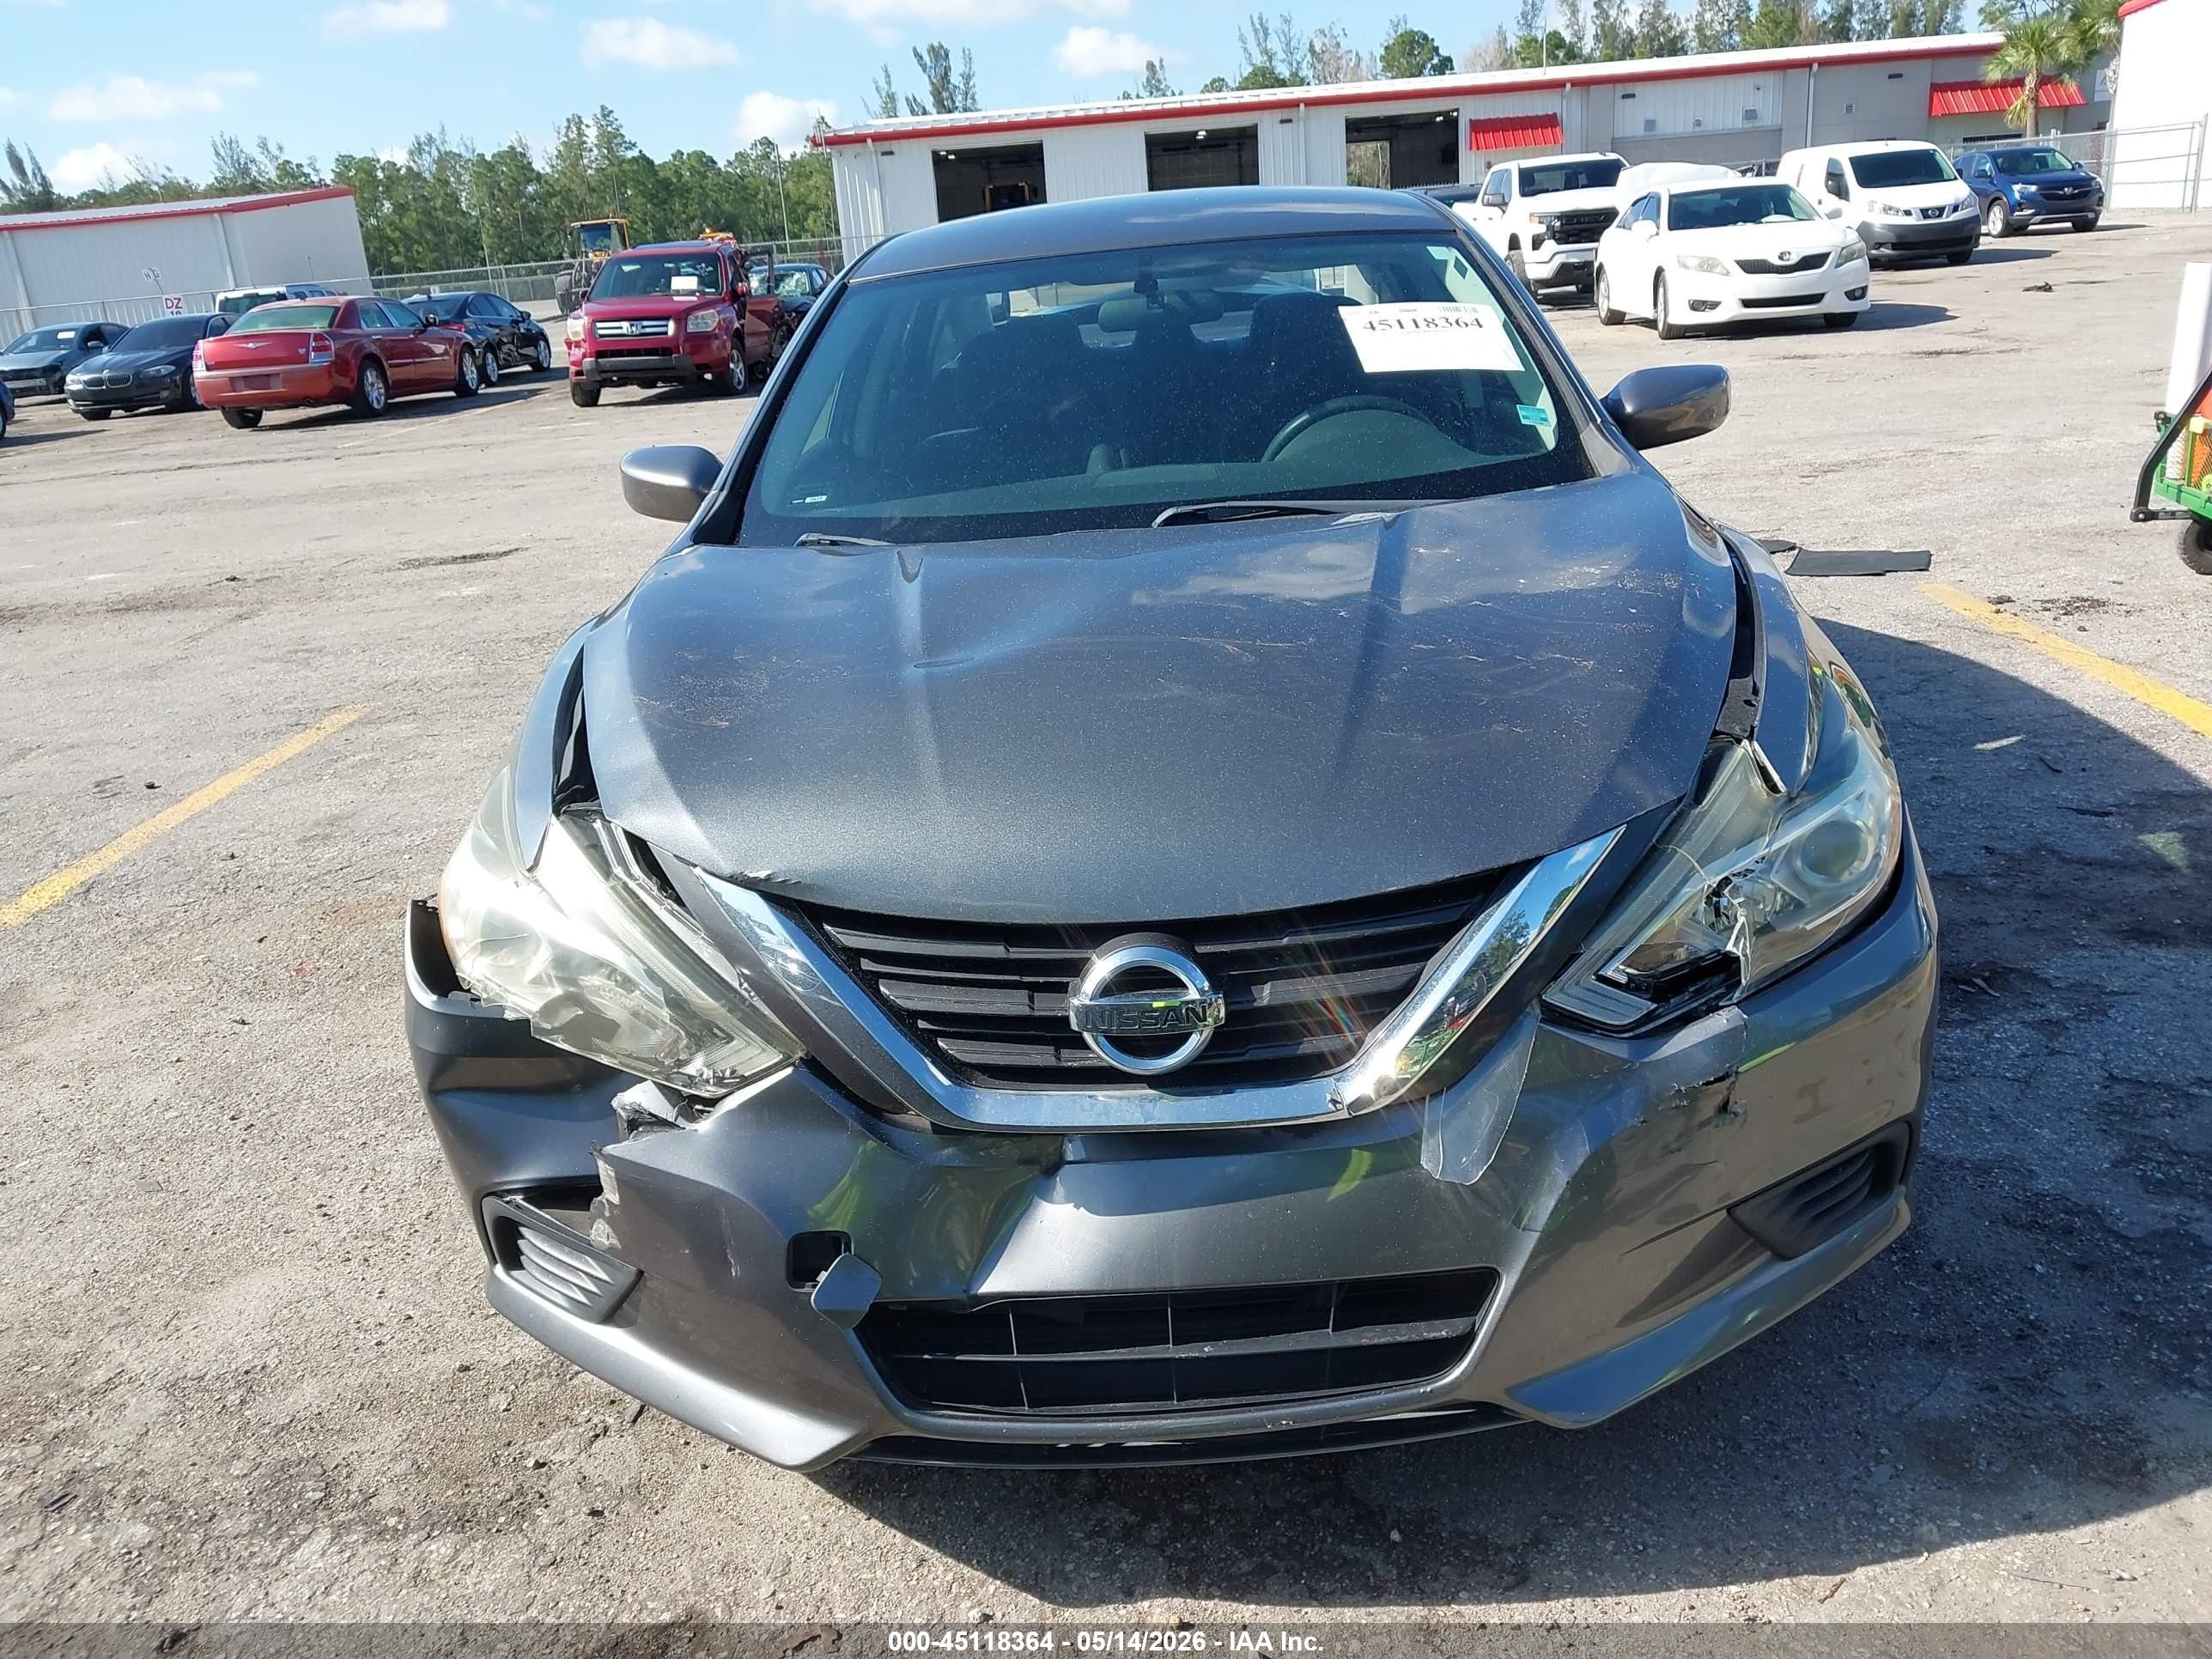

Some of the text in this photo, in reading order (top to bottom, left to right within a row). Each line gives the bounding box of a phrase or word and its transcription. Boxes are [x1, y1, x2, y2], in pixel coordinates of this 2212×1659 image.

[165, 297, 183, 309] DZ
[1363, 317, 1483, 331] 45118364
[1085, 1003, 1207, 1030] NISSAN
